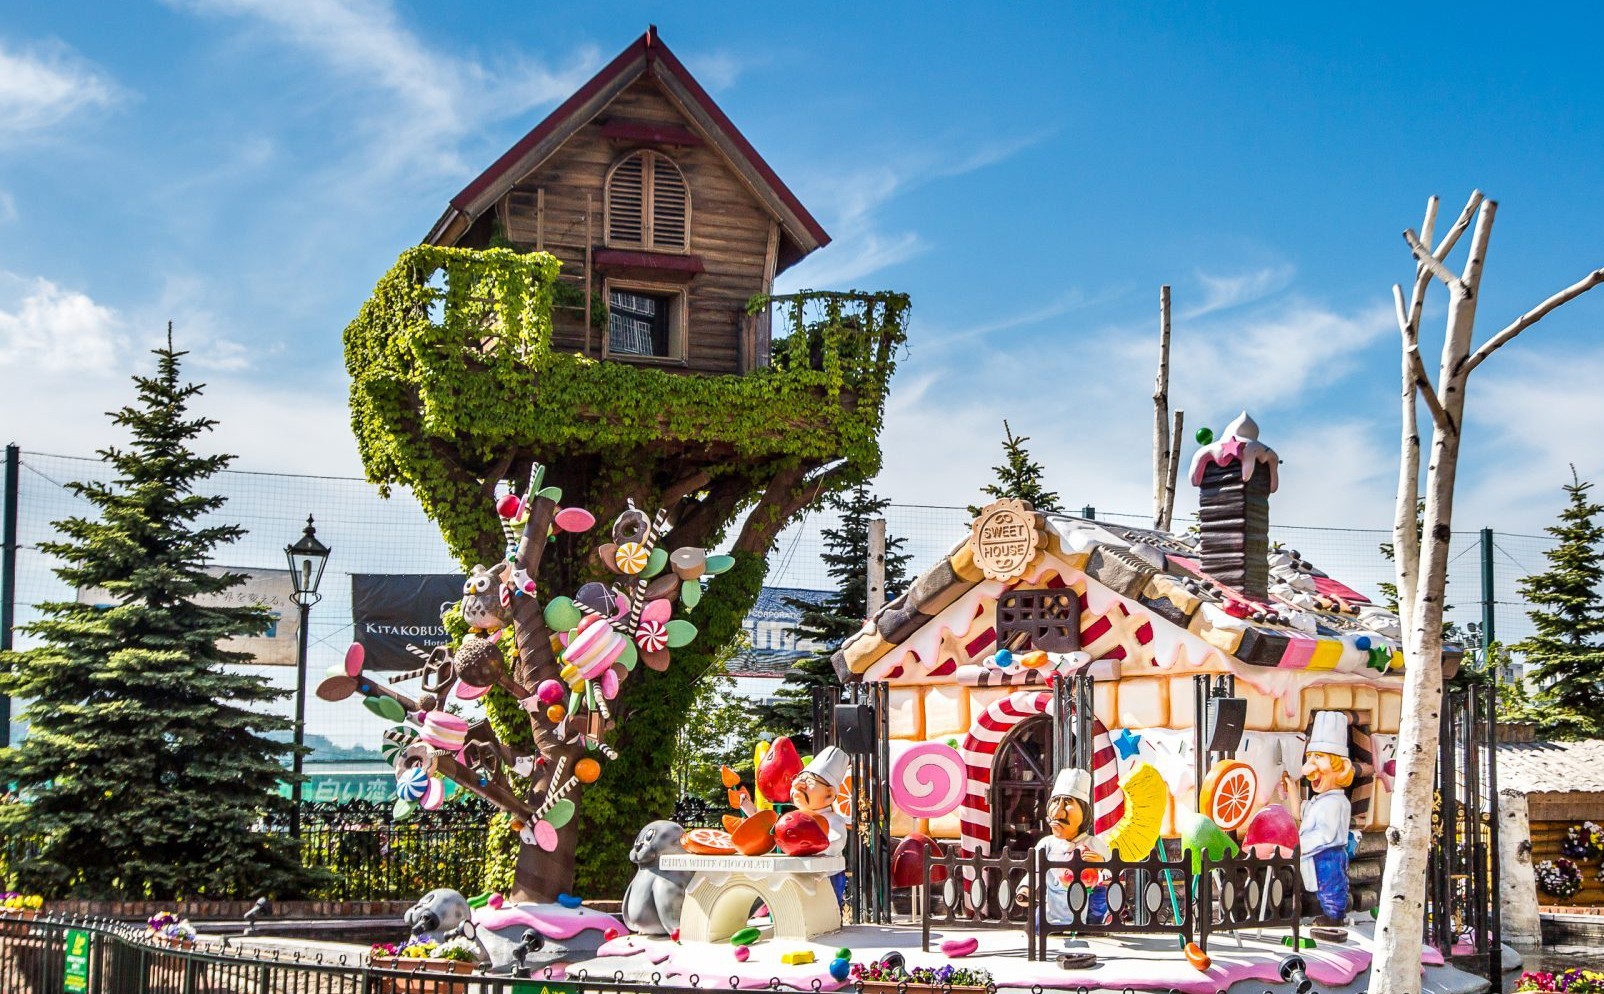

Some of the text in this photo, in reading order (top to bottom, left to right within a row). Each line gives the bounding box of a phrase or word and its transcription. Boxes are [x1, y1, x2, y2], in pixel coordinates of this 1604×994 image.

[984, 524, 1025, 539] SWEET
[984, 544, 1025, 559] HOUSE
[689, 858, 718, 868] WHITE
[719, 859, 772, 869] CHOCOLATE
